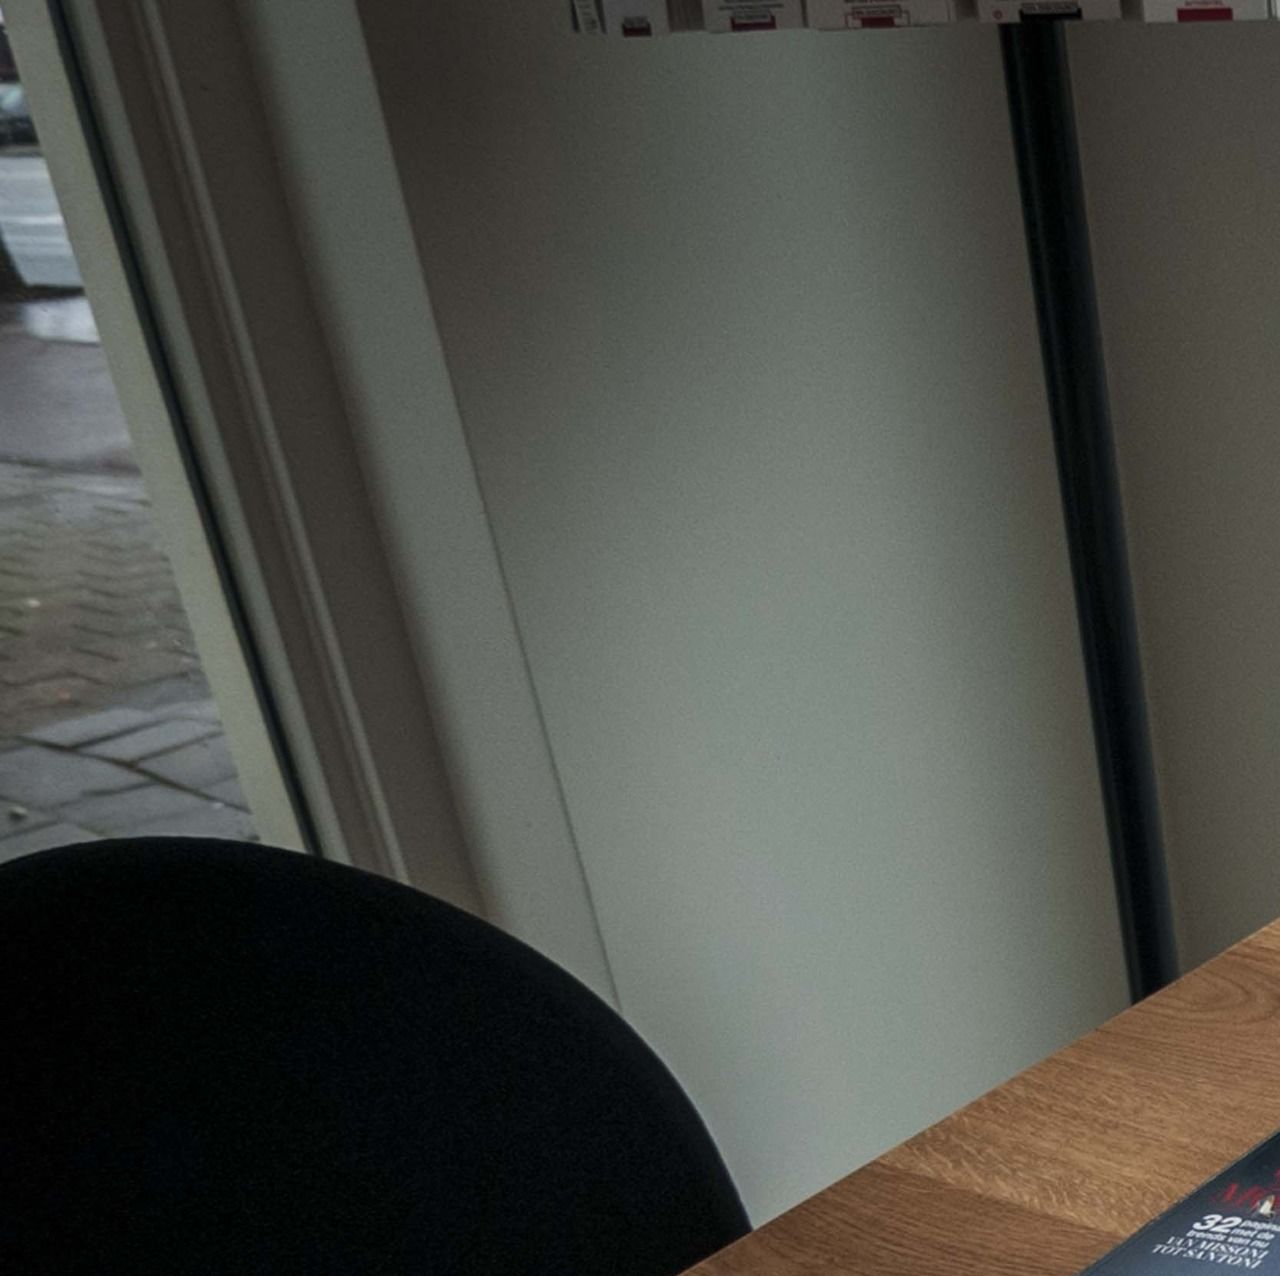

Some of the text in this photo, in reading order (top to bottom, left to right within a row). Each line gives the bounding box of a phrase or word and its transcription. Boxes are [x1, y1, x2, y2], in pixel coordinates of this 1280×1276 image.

[1192, 1214, 1241, 1234] 32
[1230, 1228, 1275, 1240] met de
[1186, 1230, 1227, 1243] trends
[1152, 1244, 1264, 1270] TOT SANTONI
[1166, 1236, 1270, 1260] VAN MISSONI
